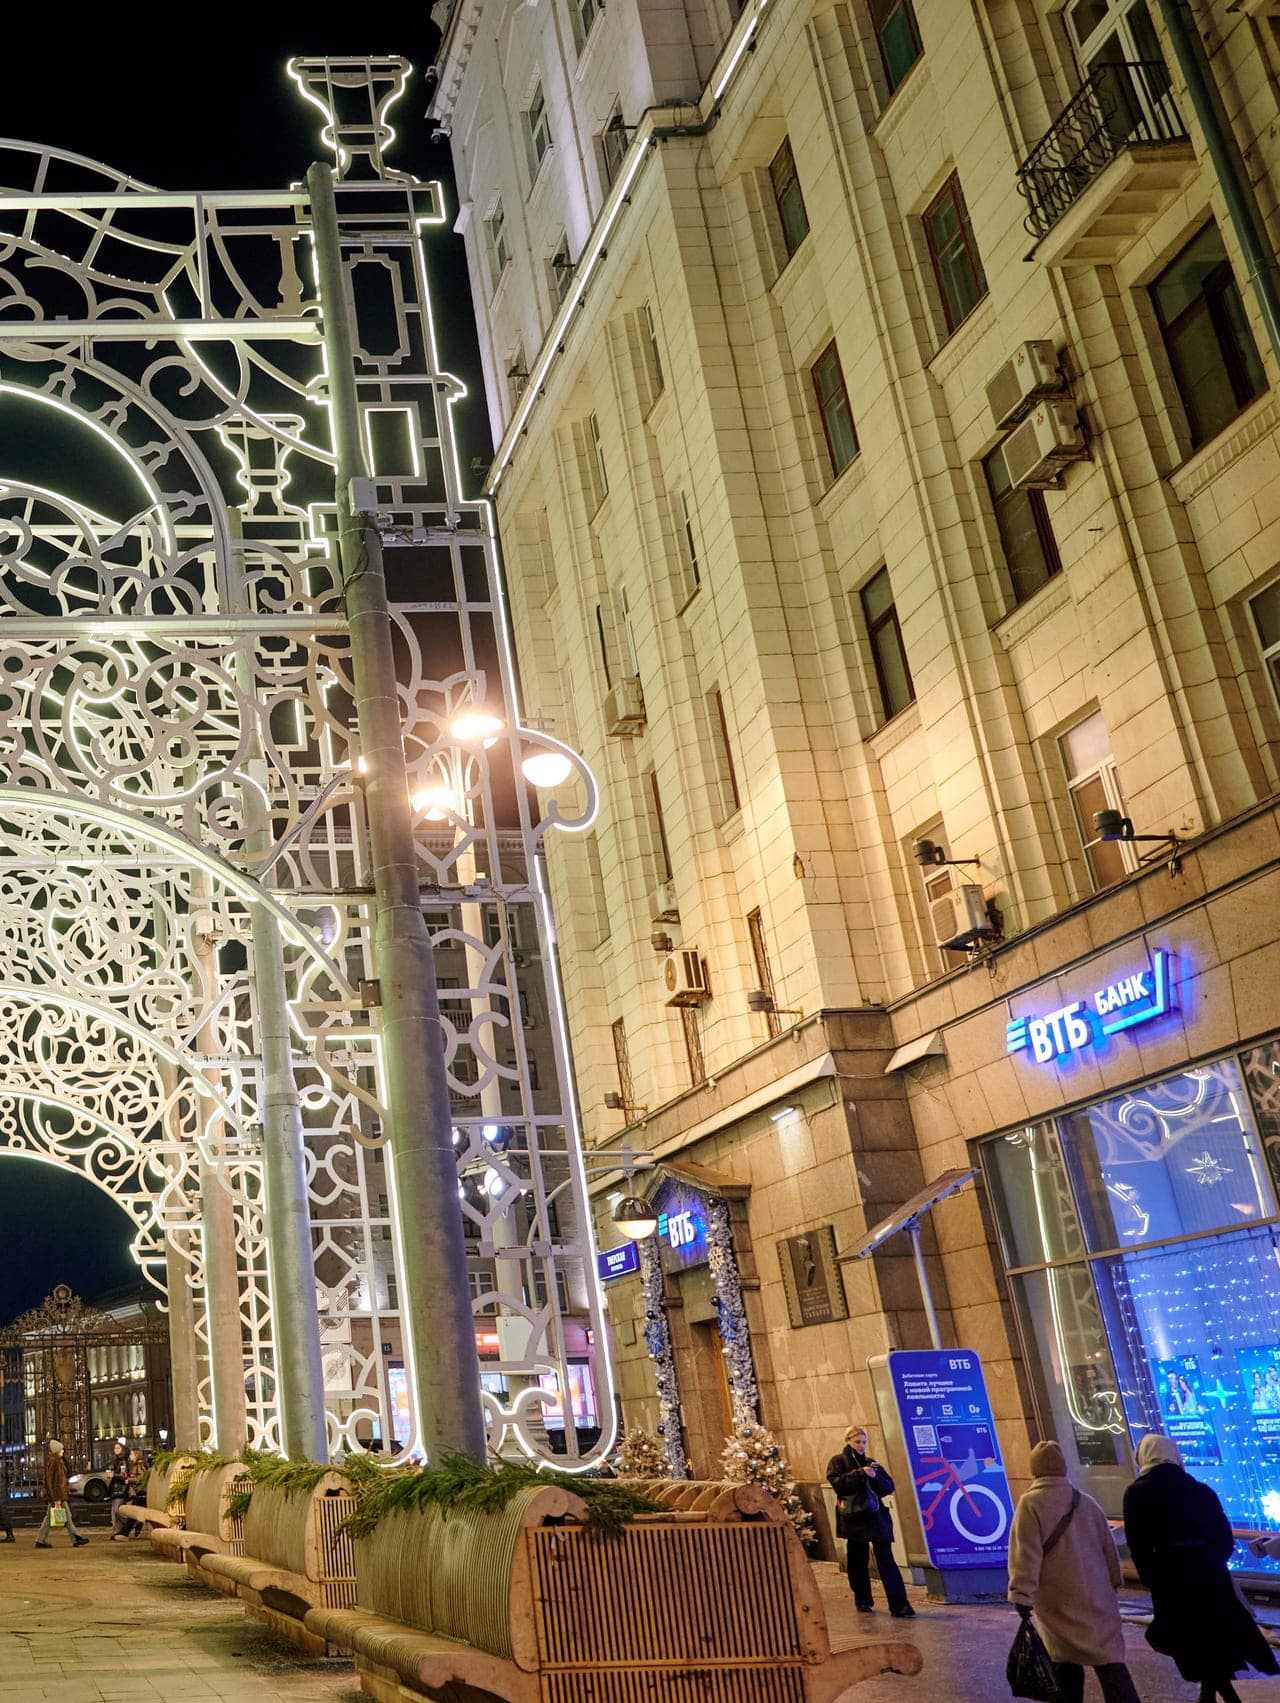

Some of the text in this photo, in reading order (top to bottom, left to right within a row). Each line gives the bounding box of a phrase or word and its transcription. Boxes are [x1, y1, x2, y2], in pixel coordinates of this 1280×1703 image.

[1029, 972, 1149, 1063] ВТБ БАНК
[668, 1211, 695, 1248] ВТБ
[949, 1359, 972, 1370] ВТБ
